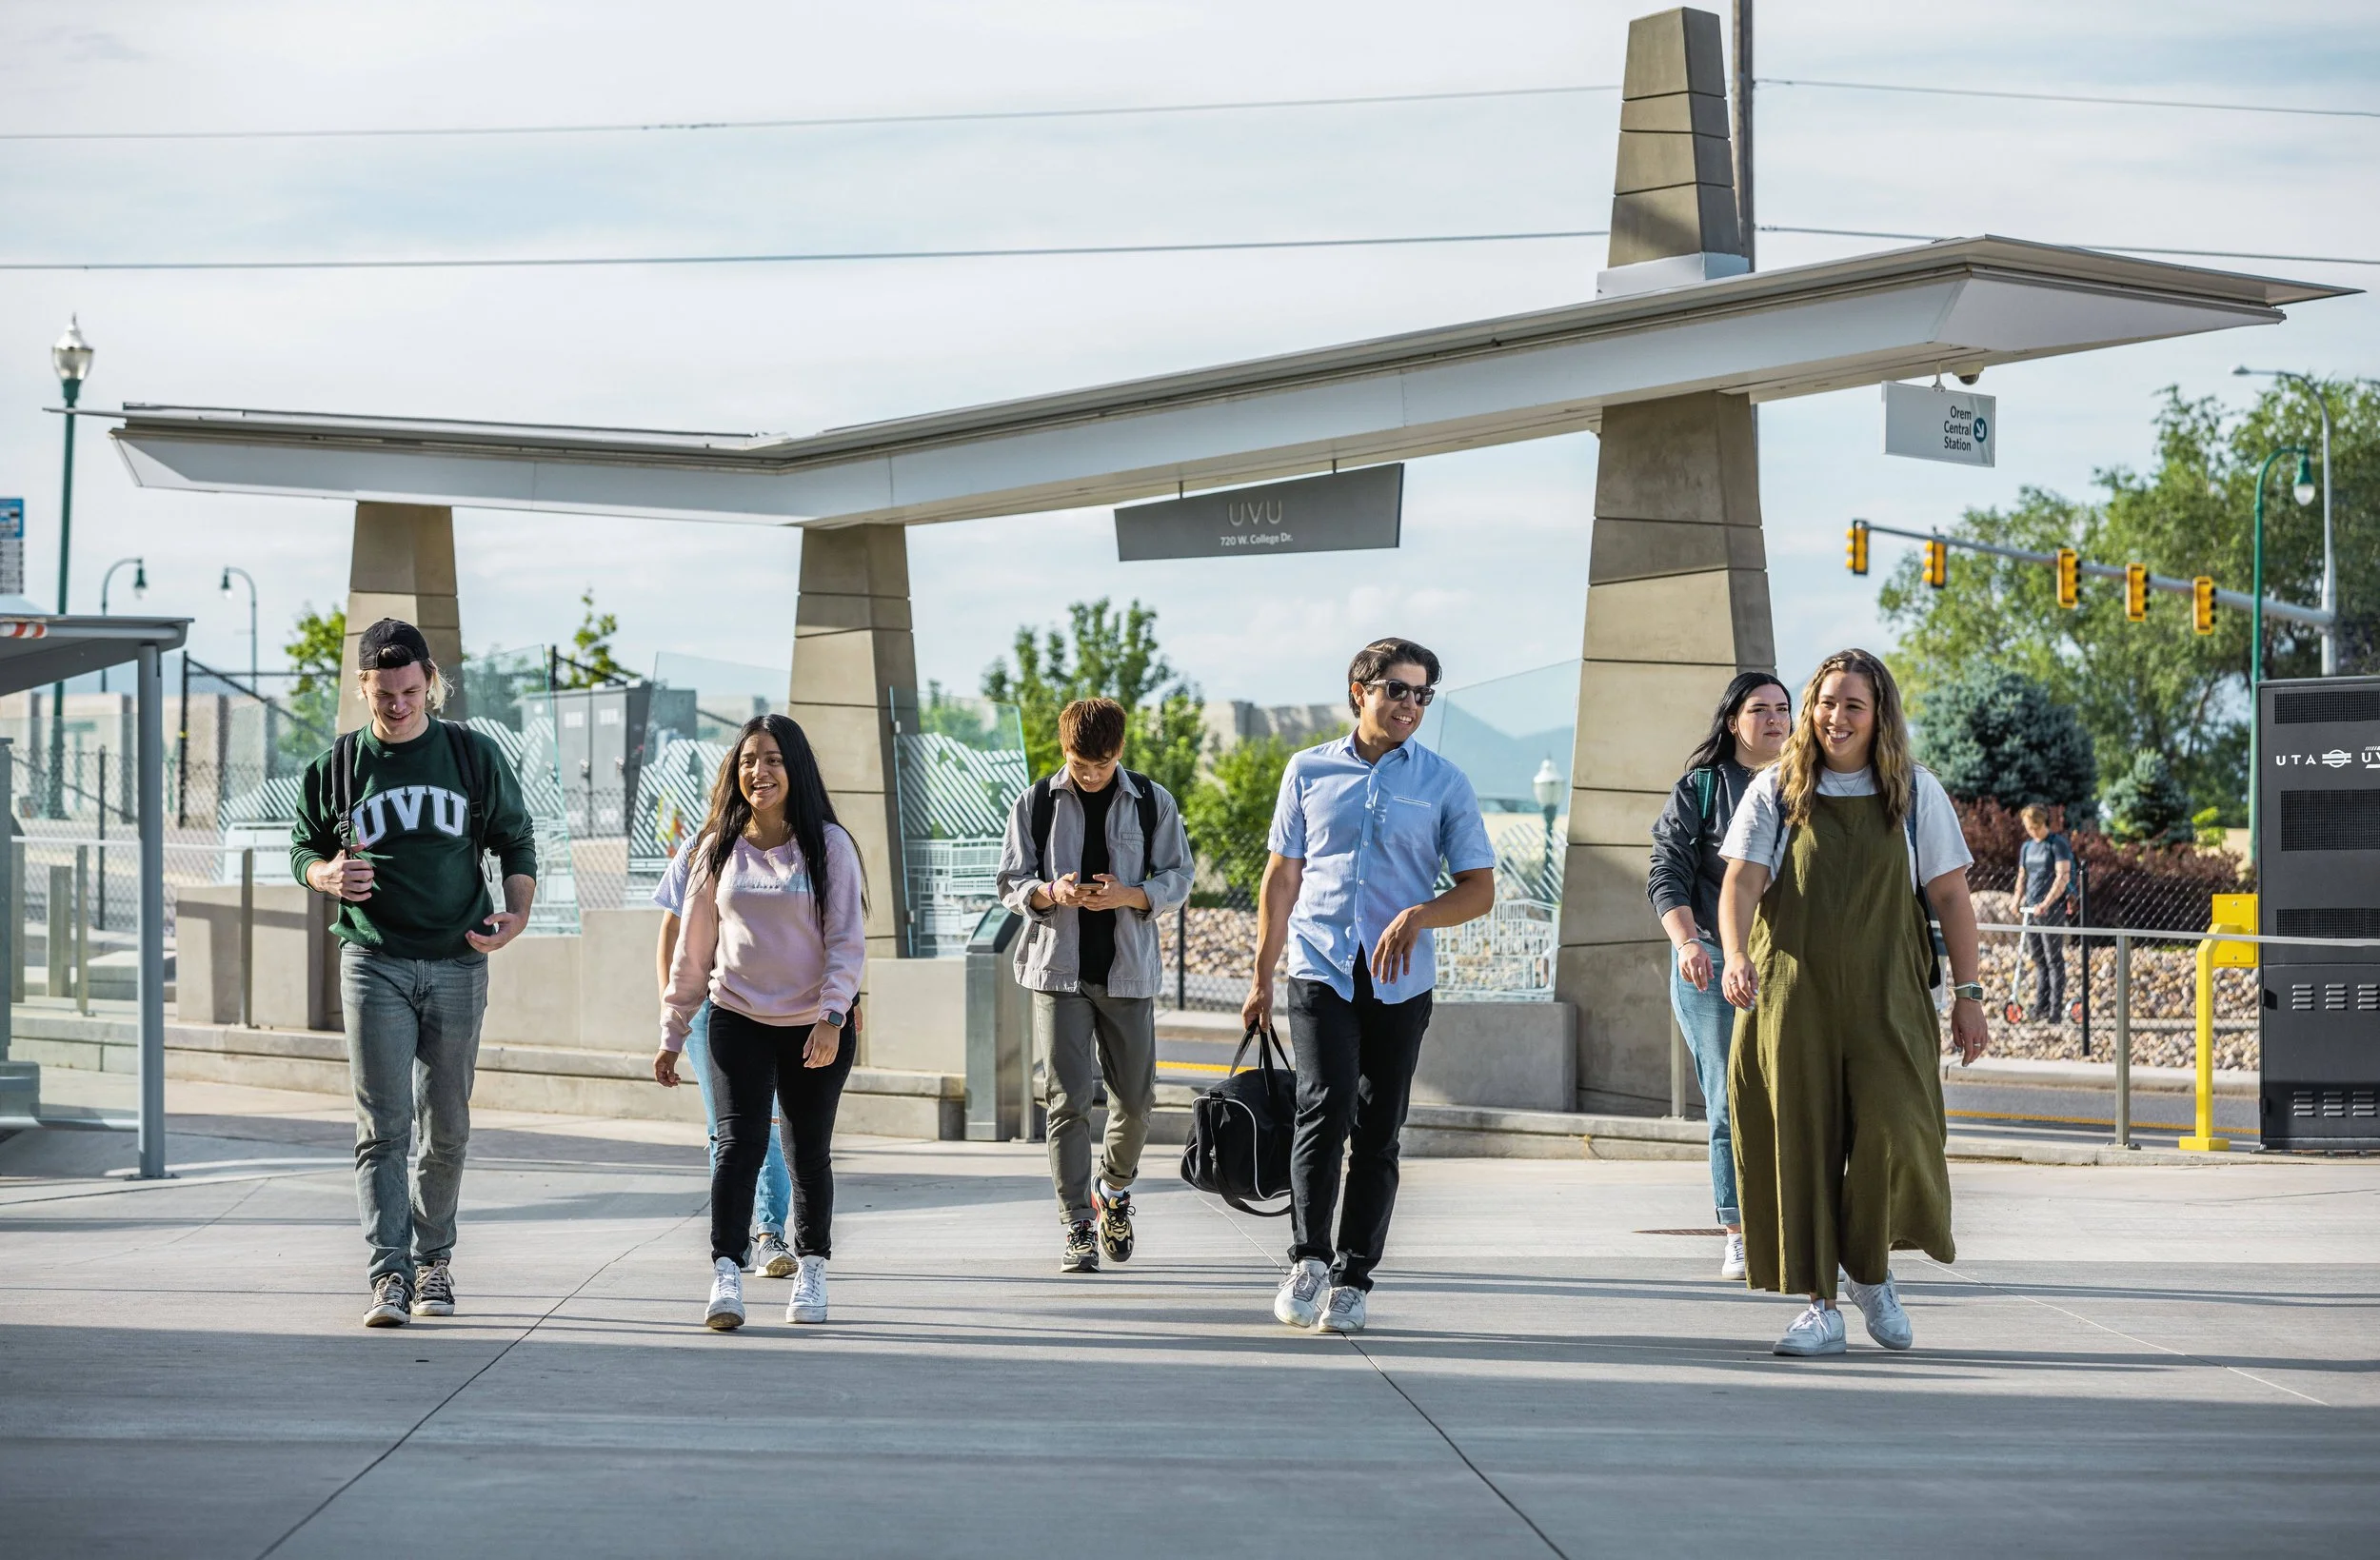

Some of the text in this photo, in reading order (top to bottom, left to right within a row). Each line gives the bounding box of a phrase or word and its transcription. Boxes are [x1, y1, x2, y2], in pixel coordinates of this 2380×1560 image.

[1950, 405, 1972, 420] Orem
[1943, 420, 1972, 436] Central
[1944, 436, 1972, 452] Station
[1228, 500, 1282, 526] UVU
[1220, 532, 1294, 547] 720 W. College Dr.
[2275, 754, 2317, 766] UTA
[350, 784, 468, 851] UVU
